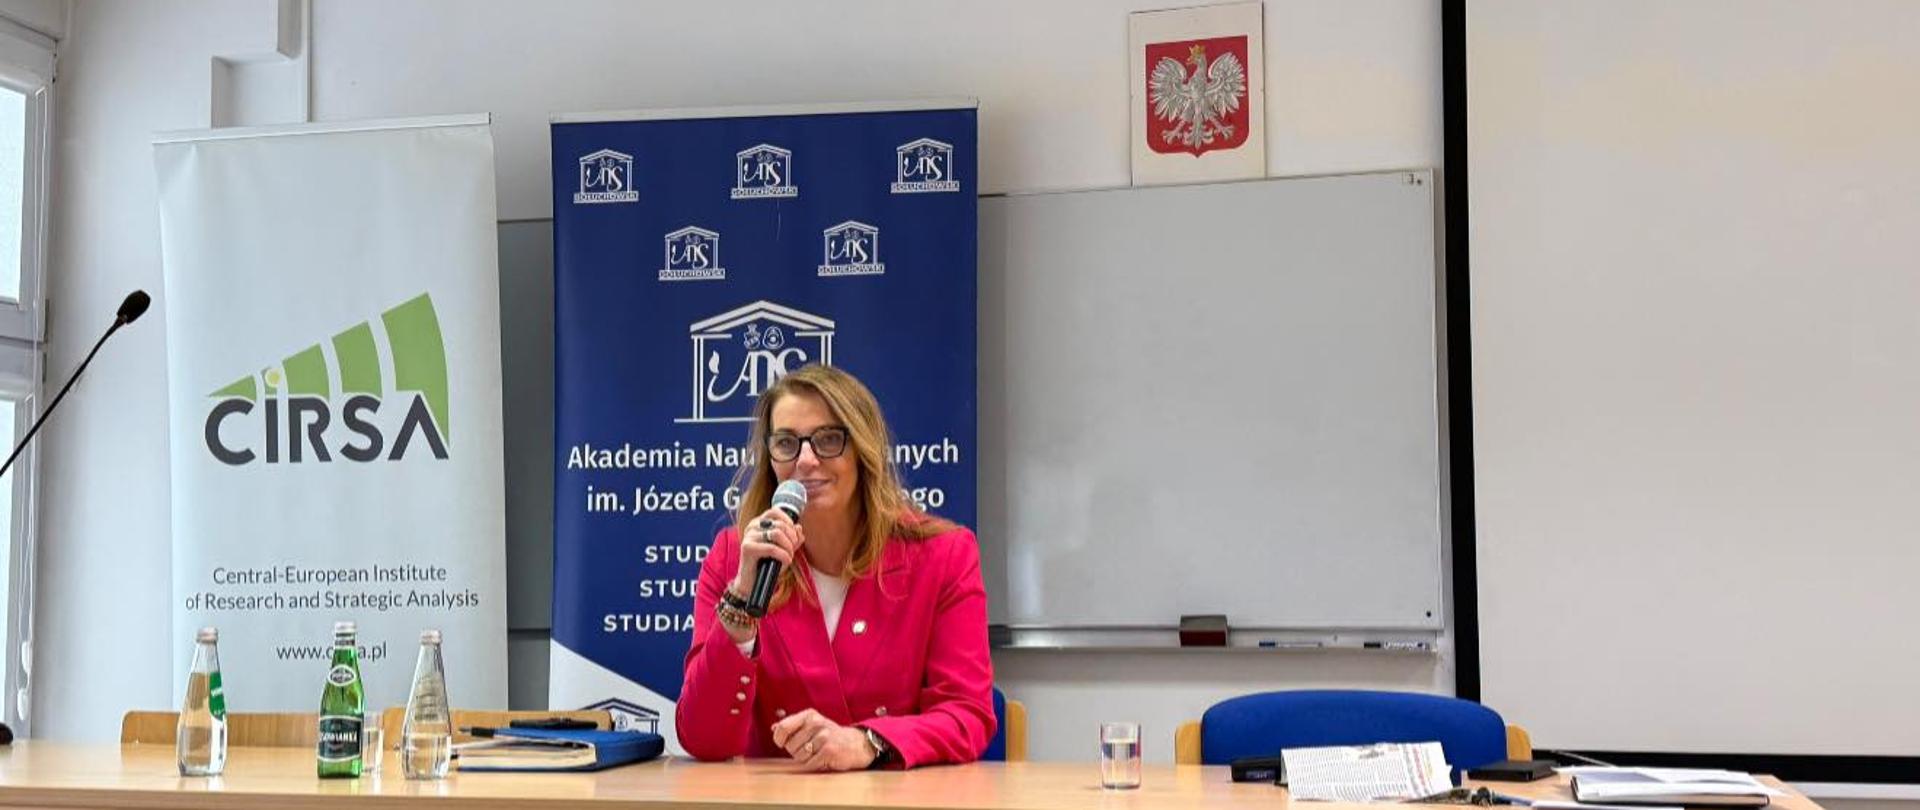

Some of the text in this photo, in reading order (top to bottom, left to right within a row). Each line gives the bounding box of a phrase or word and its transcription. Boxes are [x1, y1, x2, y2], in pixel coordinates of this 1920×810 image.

[568, 442, 755, 469] Akademia Nau
[588, 486, 624, 511] im.
[633, 485, 714, 516] Józefa
[645, 546, 709, 563] STUD
[213, 564, 446, 586] Central-European Institute
[185, 588, 478, 611] of Research and Strategic Analysis
[640, 580, 698, 597] STUD
[276, 641, 387, 662] www.ca.pl
